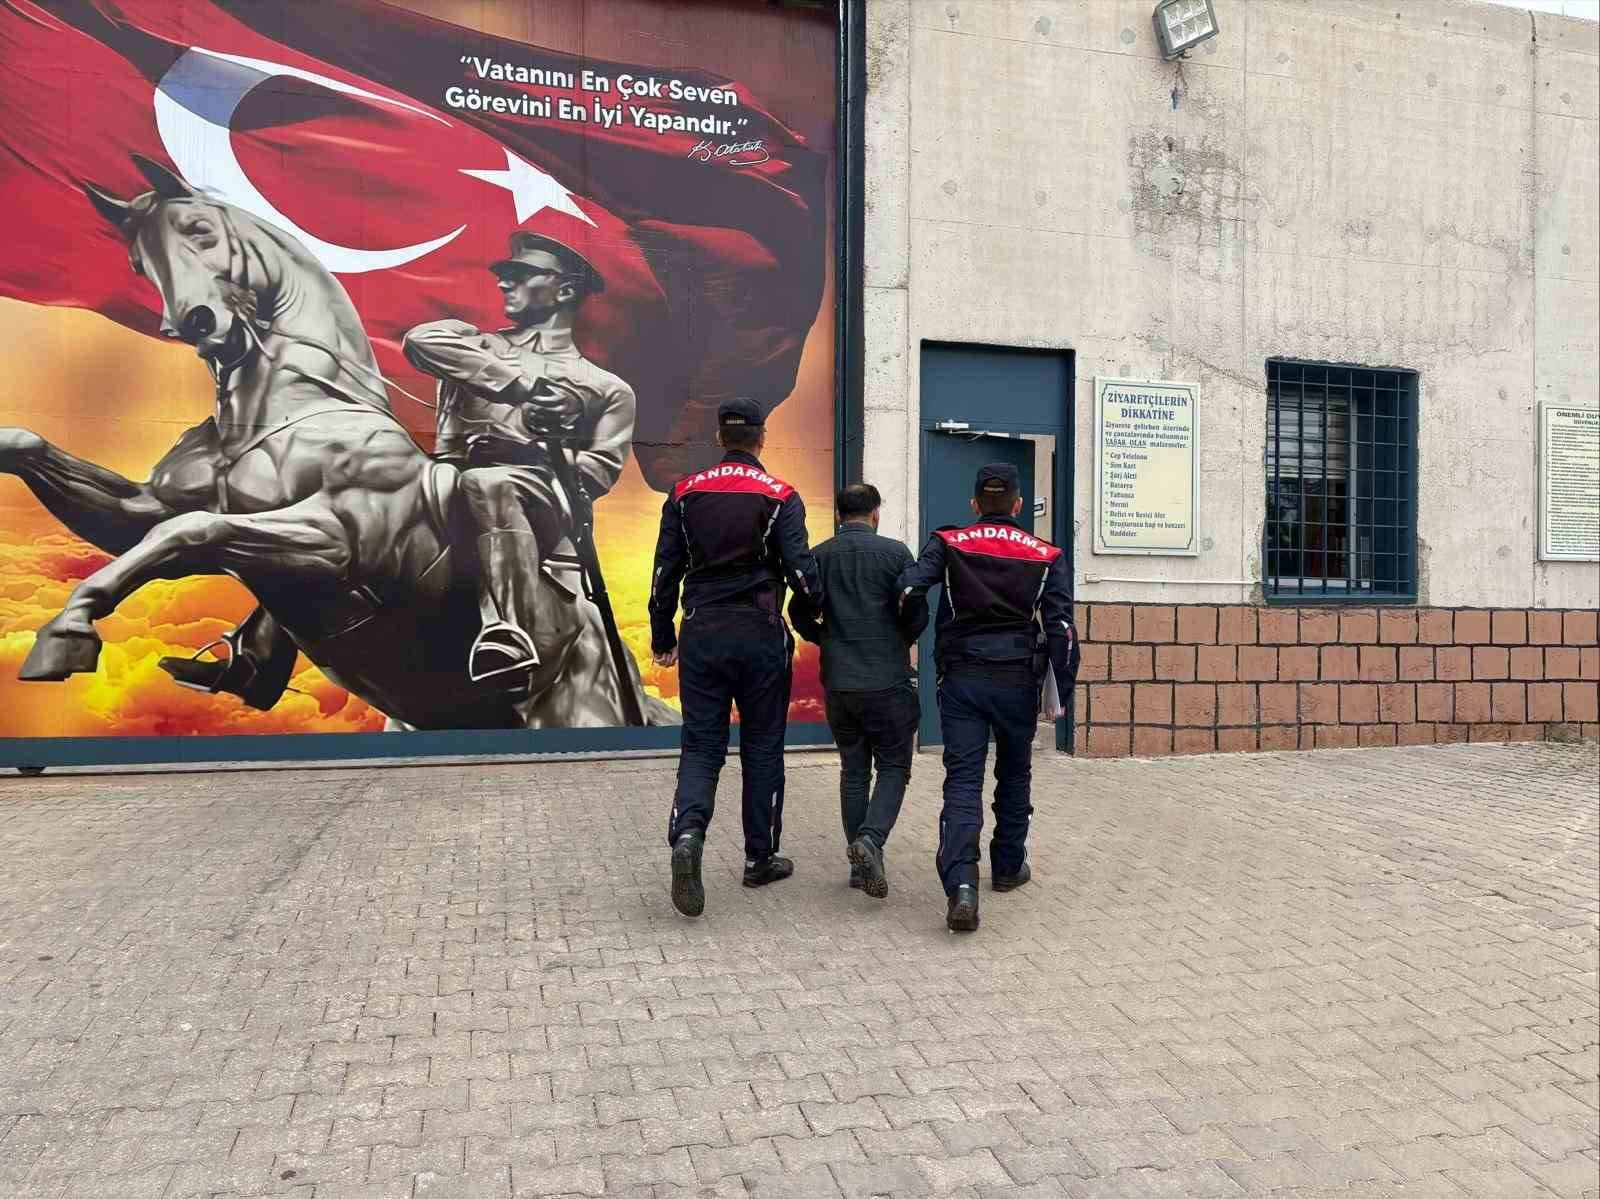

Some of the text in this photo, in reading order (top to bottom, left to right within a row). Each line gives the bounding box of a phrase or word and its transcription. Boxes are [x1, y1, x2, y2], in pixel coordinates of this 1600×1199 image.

[581, 70, 609, 93] En
[616, 74, 661, 100] Çok
[671, 81, 737, 106] Seven
[445, 86, 551, 118] Görevini
[558, 99, 586, 121] En
[594, 95, 622, 130] İyi
[1107, 391, 1188, 408] ZİYARETÇİLERİN
[1121, 406, 1175, 420] DİKKATİNE
[1110, 452, 1121, 460] Cep
